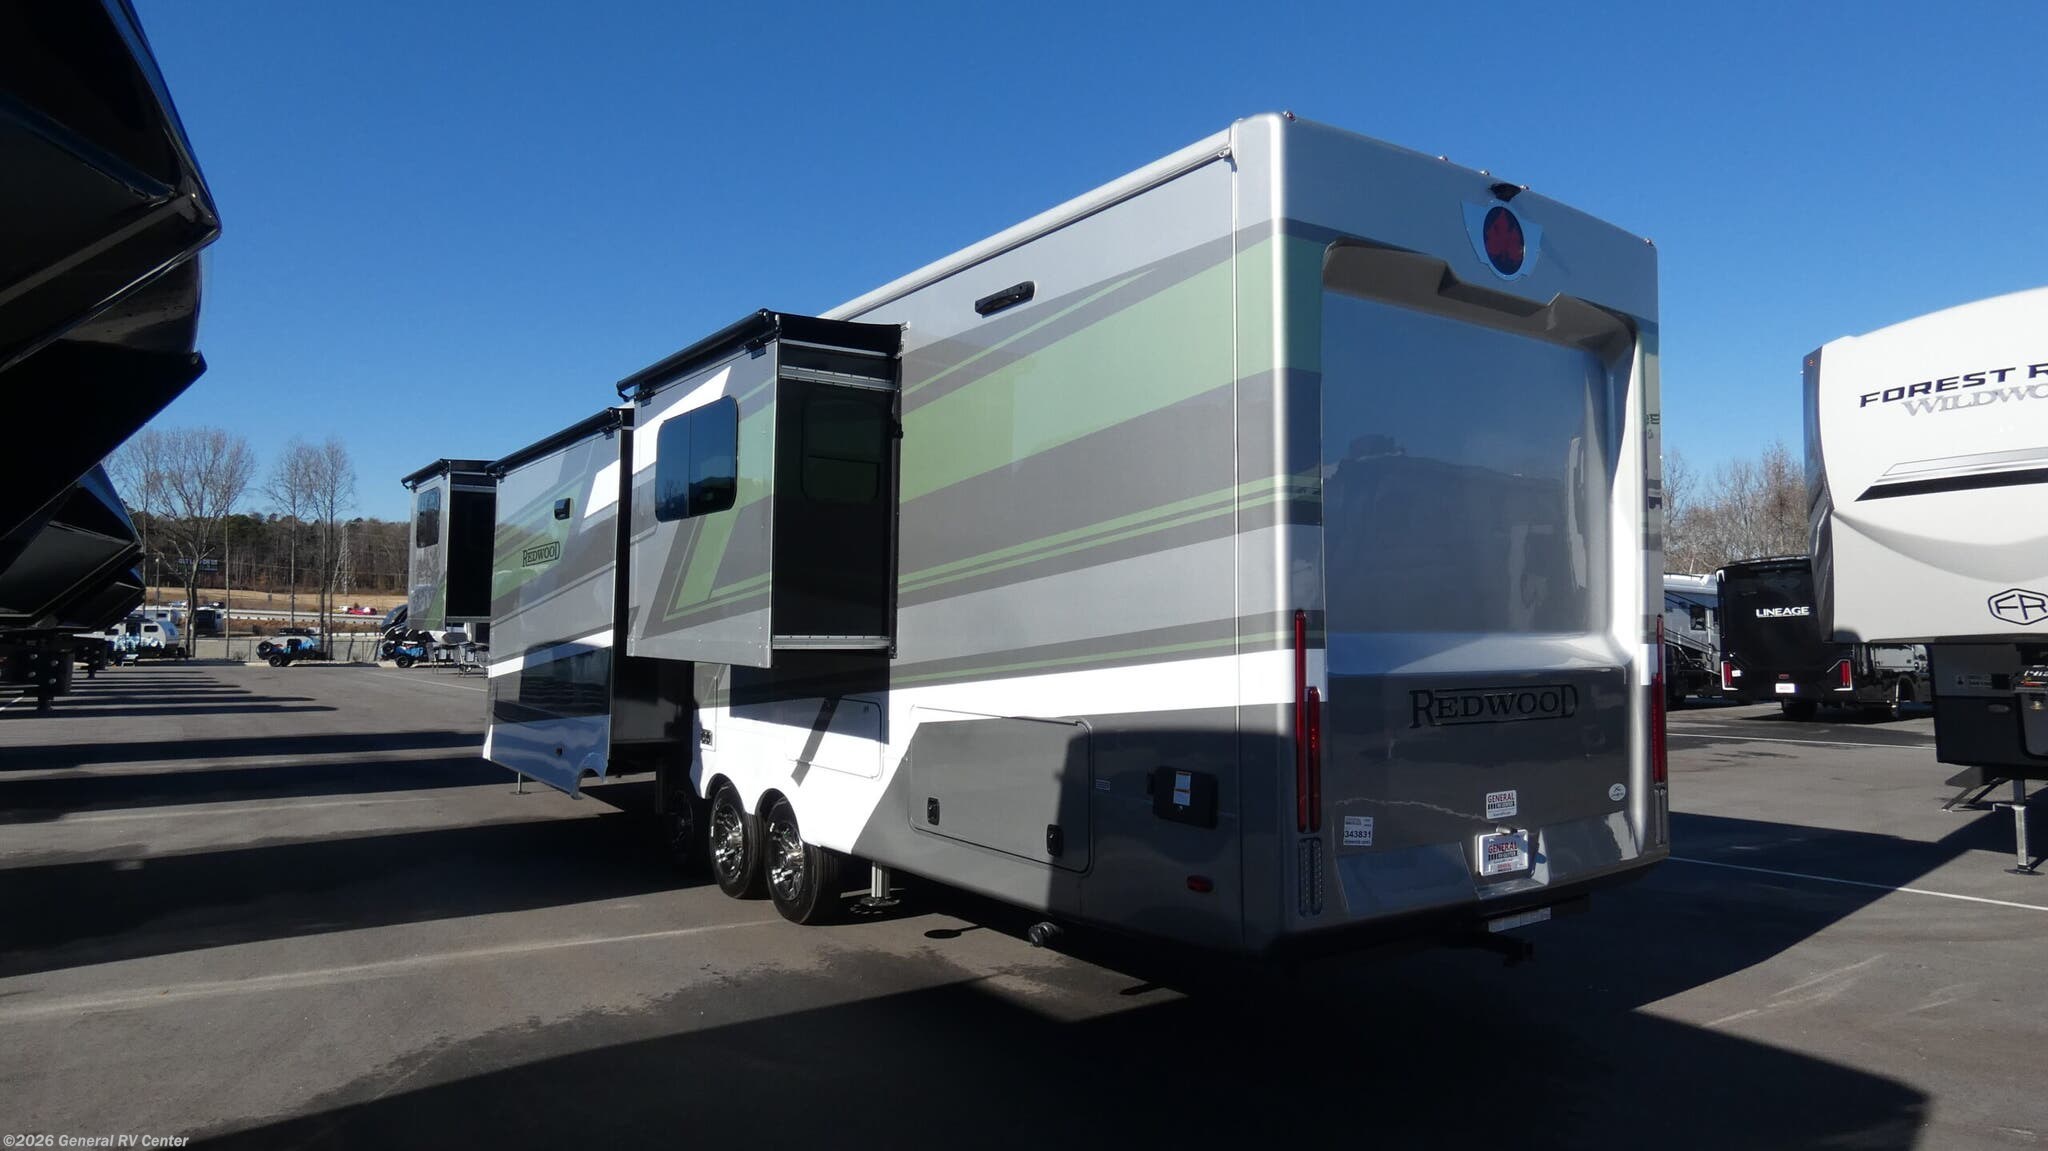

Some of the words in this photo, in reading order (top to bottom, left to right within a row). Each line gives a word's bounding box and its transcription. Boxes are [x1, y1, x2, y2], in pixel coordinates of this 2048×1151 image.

[1859, 366, 2017, 409] FOREST
[522, 541, 561, 567] REDWOOD
[1755, 606, 1810, 618] LINEAGE
[1409, 684, 1578, 729] REDWOOD
[1487, 792, 1515, 803] GENERAL
[1487, 841, 1518, 854] GENERAL
